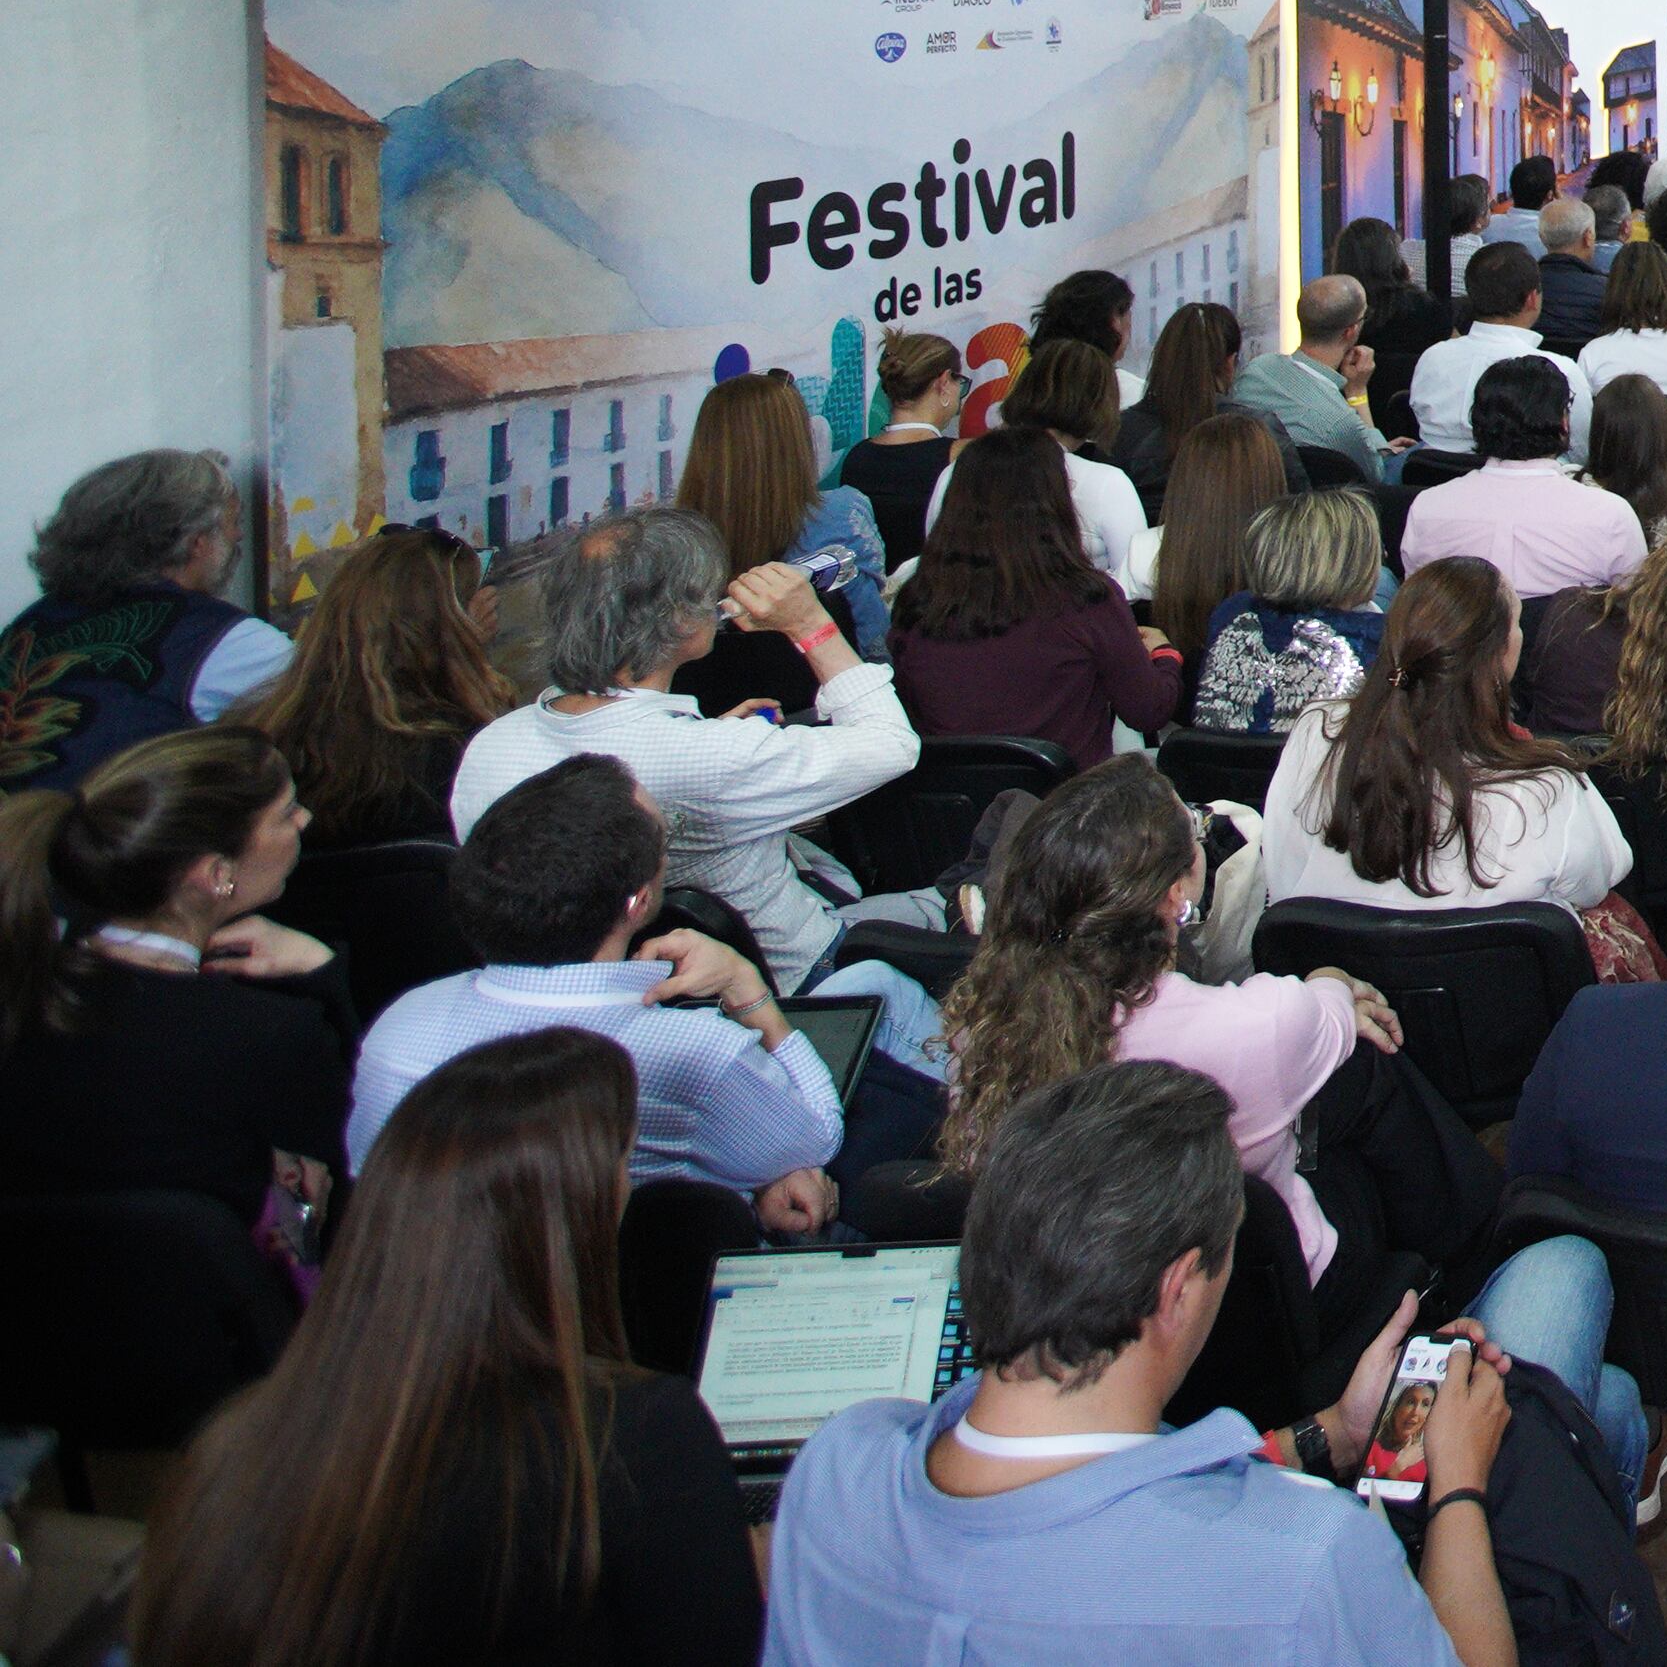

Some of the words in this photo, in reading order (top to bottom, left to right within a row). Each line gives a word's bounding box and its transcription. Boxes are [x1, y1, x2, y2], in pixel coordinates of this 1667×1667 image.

[895, 4, 923, 13] GROUP
[926, 31, 957, 45] AMOR
[926, 45, 957, 54] PERFECTO
[750, 131, 1076, 285] Festival
[874, 276, 922, 323] de
[934, 266, 983, 309] las
